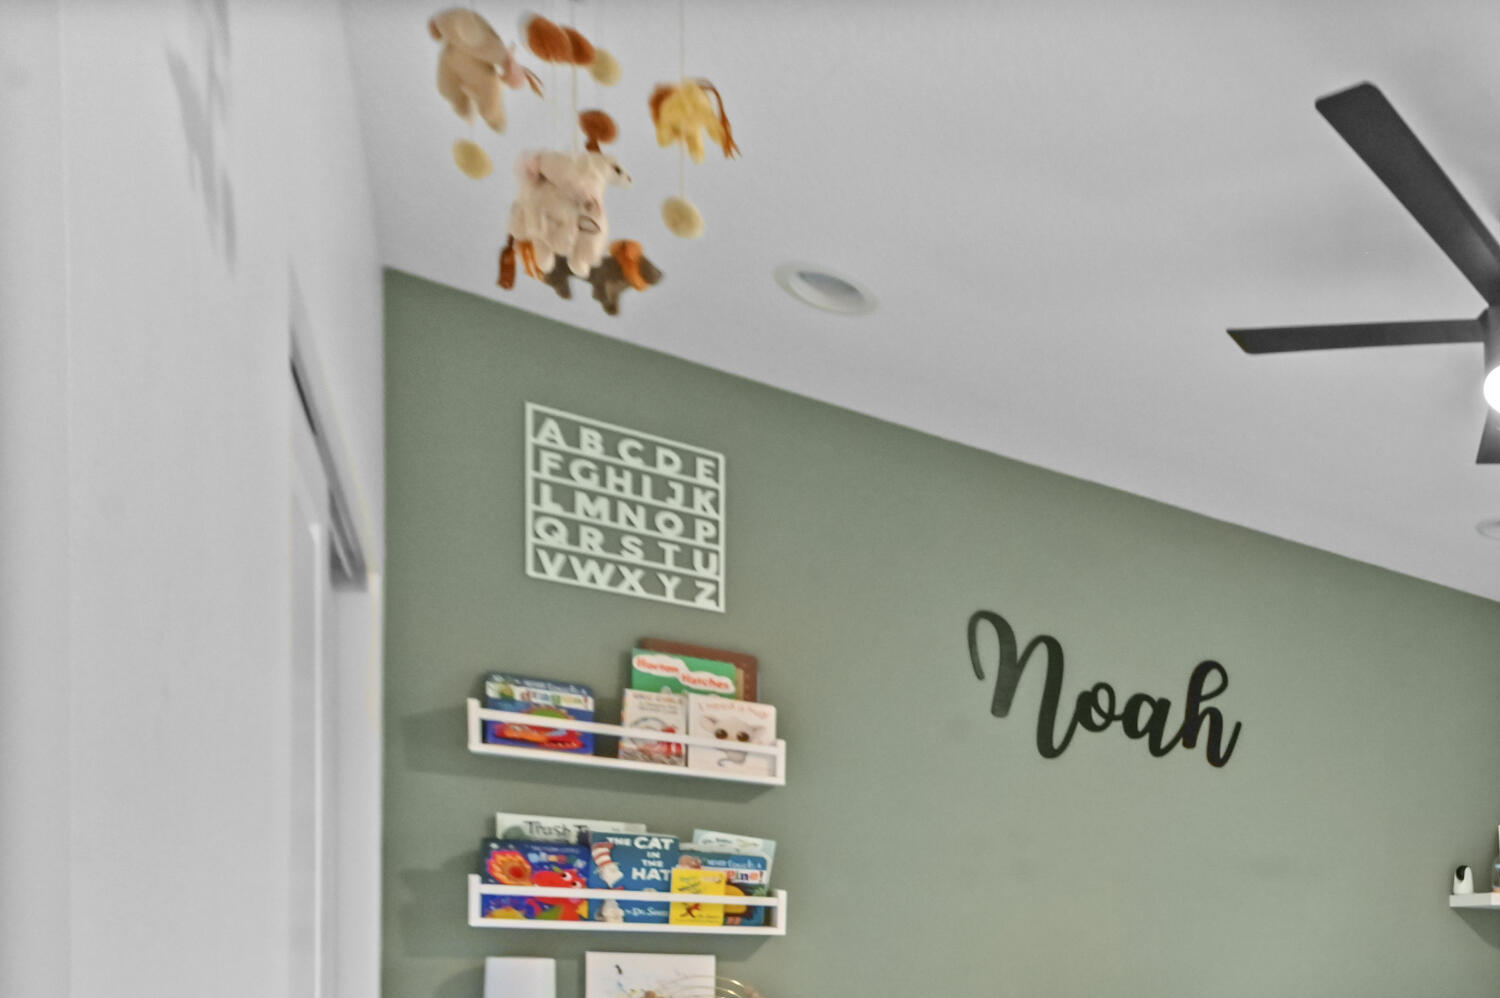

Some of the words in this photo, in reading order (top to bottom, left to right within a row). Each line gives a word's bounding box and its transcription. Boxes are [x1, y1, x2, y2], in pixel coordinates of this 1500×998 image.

[681, 674, 730, 690] Hatches
[967, 609, 1242, 768] Noah
[524, 820, 572, 838] Trash
[606, 836, 632, 847] THE
[633, 836, 675, 851] CAT
[647, 851, 661, 860] IN
[642, 859, 663, 868] THE
[632, 867, 671, 882] HAT
